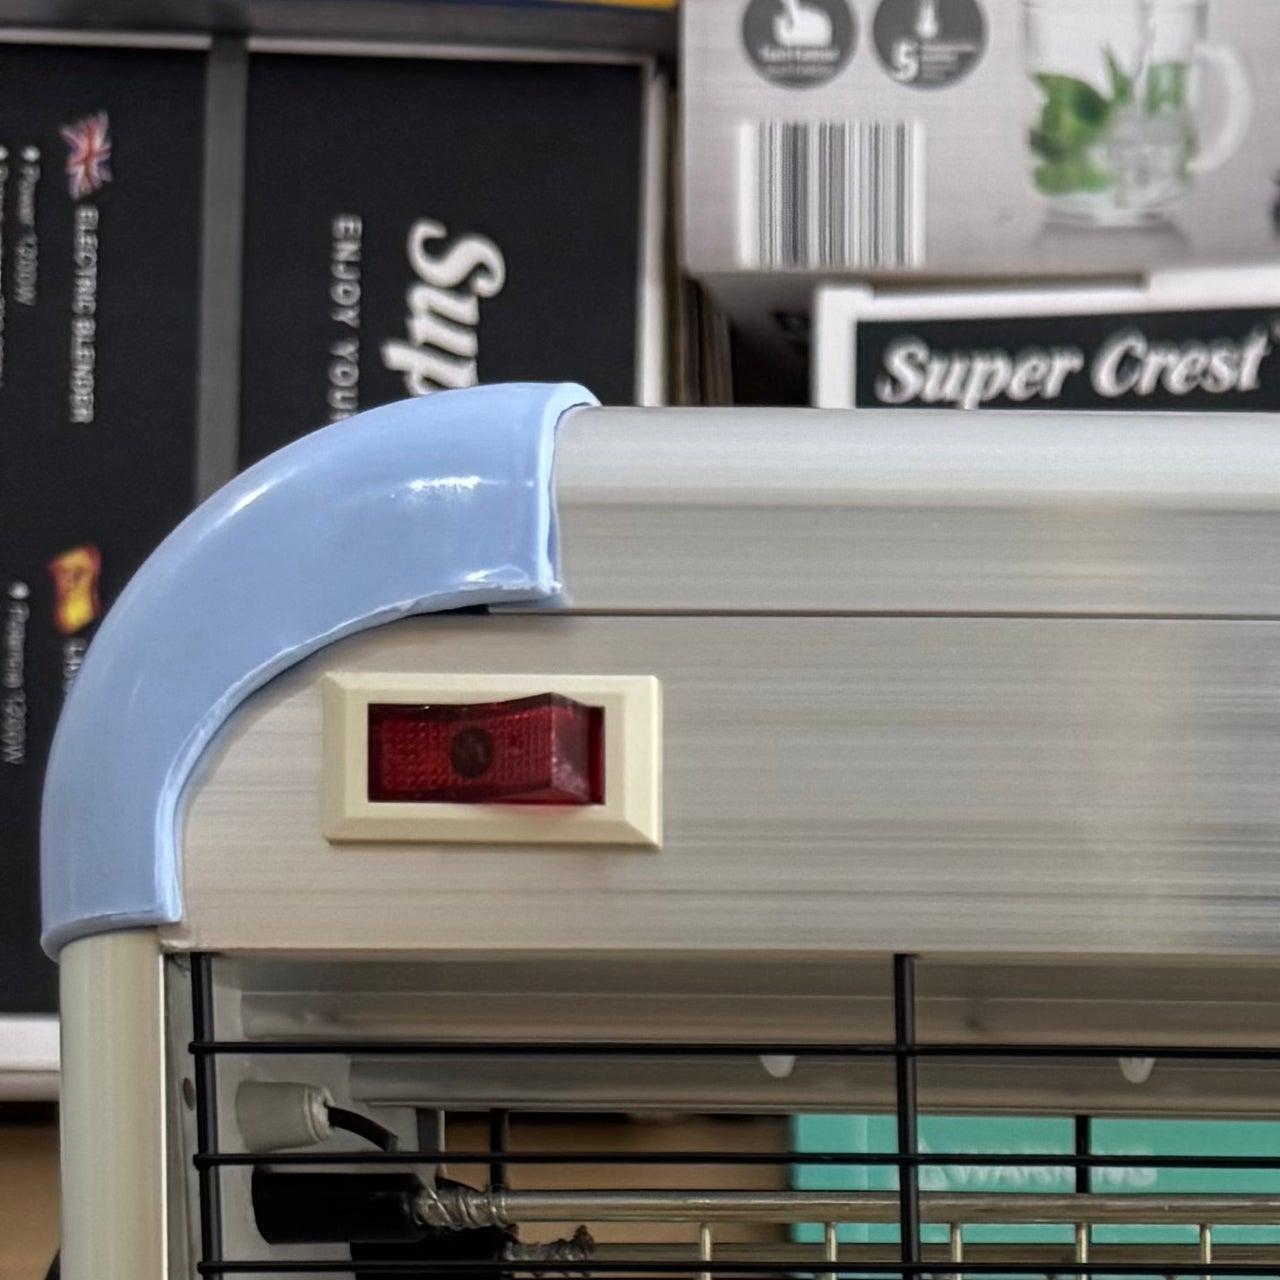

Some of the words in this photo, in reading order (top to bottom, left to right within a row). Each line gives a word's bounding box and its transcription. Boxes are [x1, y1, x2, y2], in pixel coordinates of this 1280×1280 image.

[72, 205, 100, 315] ELECTRIC
[329, 213, 363, 328] ENJOY
[69, 318, 97, 424] BLENDER
[875, 335, 1084, 410] Super
[1091, 322, 1272, 398] Crest
